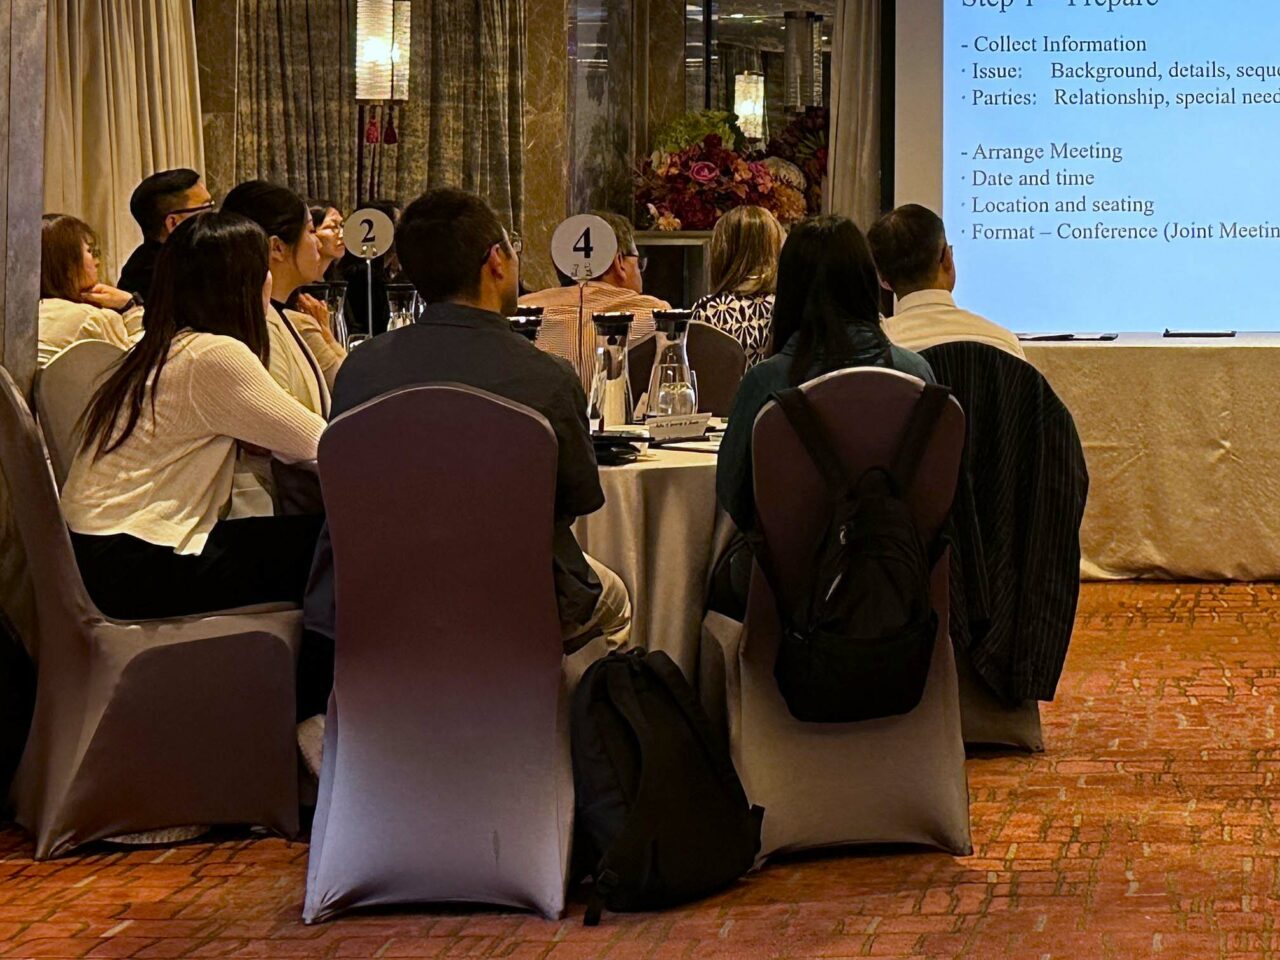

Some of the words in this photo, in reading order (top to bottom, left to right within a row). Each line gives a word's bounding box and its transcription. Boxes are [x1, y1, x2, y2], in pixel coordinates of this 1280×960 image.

[973, 34, 1038, 54] Collect
[1042, 33, 1149, 54] Information
[971, 61, 1024, 80] Issue:
[1050, 60, 1163, 83] Background,
[1167, 59, 1230, 81] details,
[971, 87, 1036, 106] Parties:
[1053, 85, 1169, 110] Relationship,
[1175, 86, 1236, 110] special
[971, 142, 1044, 163] Arrange
[1049, 141, 1123, 164] Meeting
[971, 168, 1013, 187] Date
[1018, 167, 1050, 187] and
[1055, 167, 1094, 187] time
[971, 194, 1049, 214] Location
[1054, 194, 1086, 214] and
[1091, 194, 1154, 217] seating
[359, 218, 376, 243] 2
[572, 226, 593, 258] 4
[971, 221, 1035, 240] Format
[1056, 220, 1158, 240] Conference
[1163, 220, 1213, 243] (Joint
